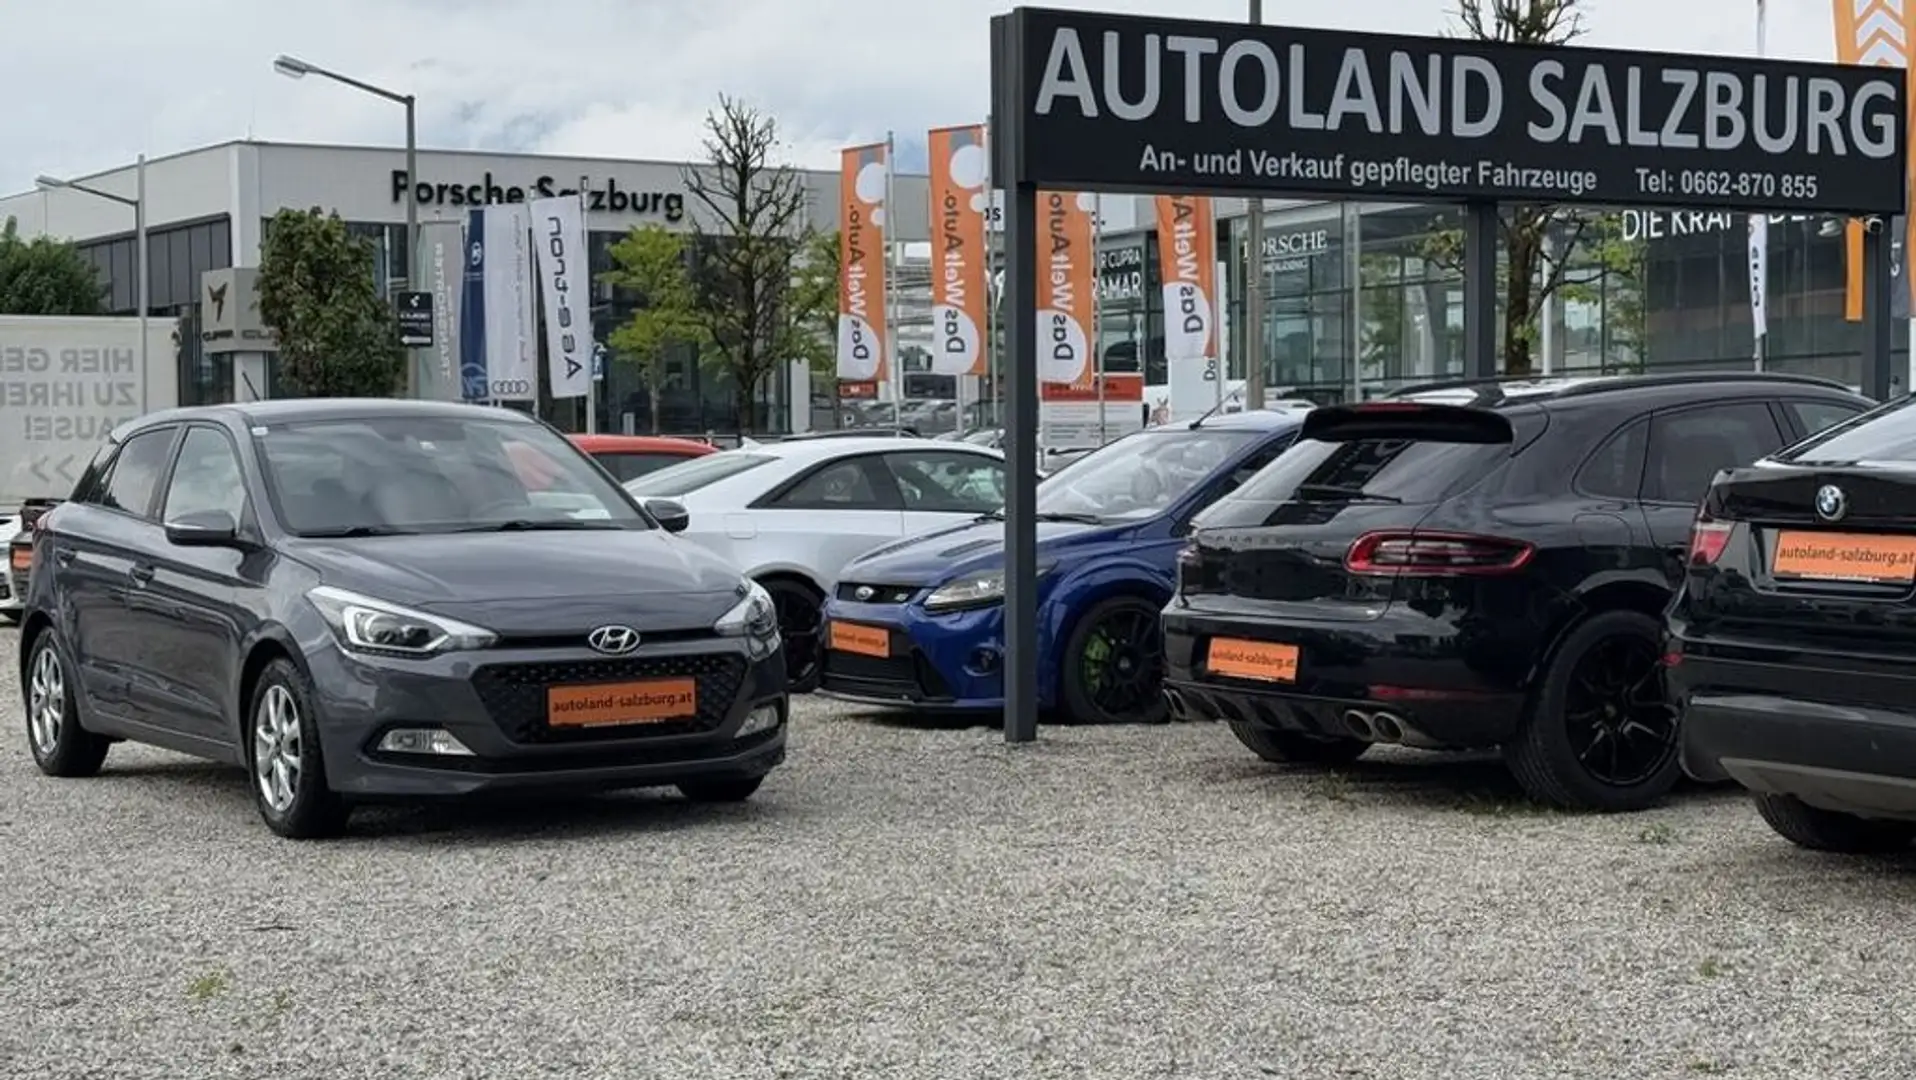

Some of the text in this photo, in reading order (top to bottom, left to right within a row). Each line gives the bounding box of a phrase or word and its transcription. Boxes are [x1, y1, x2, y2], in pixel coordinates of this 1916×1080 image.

[1035, 27, 1896, 159] AUTOLAND SALZBURG
[1140, 144, 1597, 195] An- und Verkauf gepflegter Fahrzeuge
[1636, 167, 1818, 198] Tel: 0662-870 855
[1621, 210, 1663, 241] DIE
[1779, 546, 1915, 565] autoland-salzburg.at
[552, 691, 693, 713] autoland-salzburg.at
